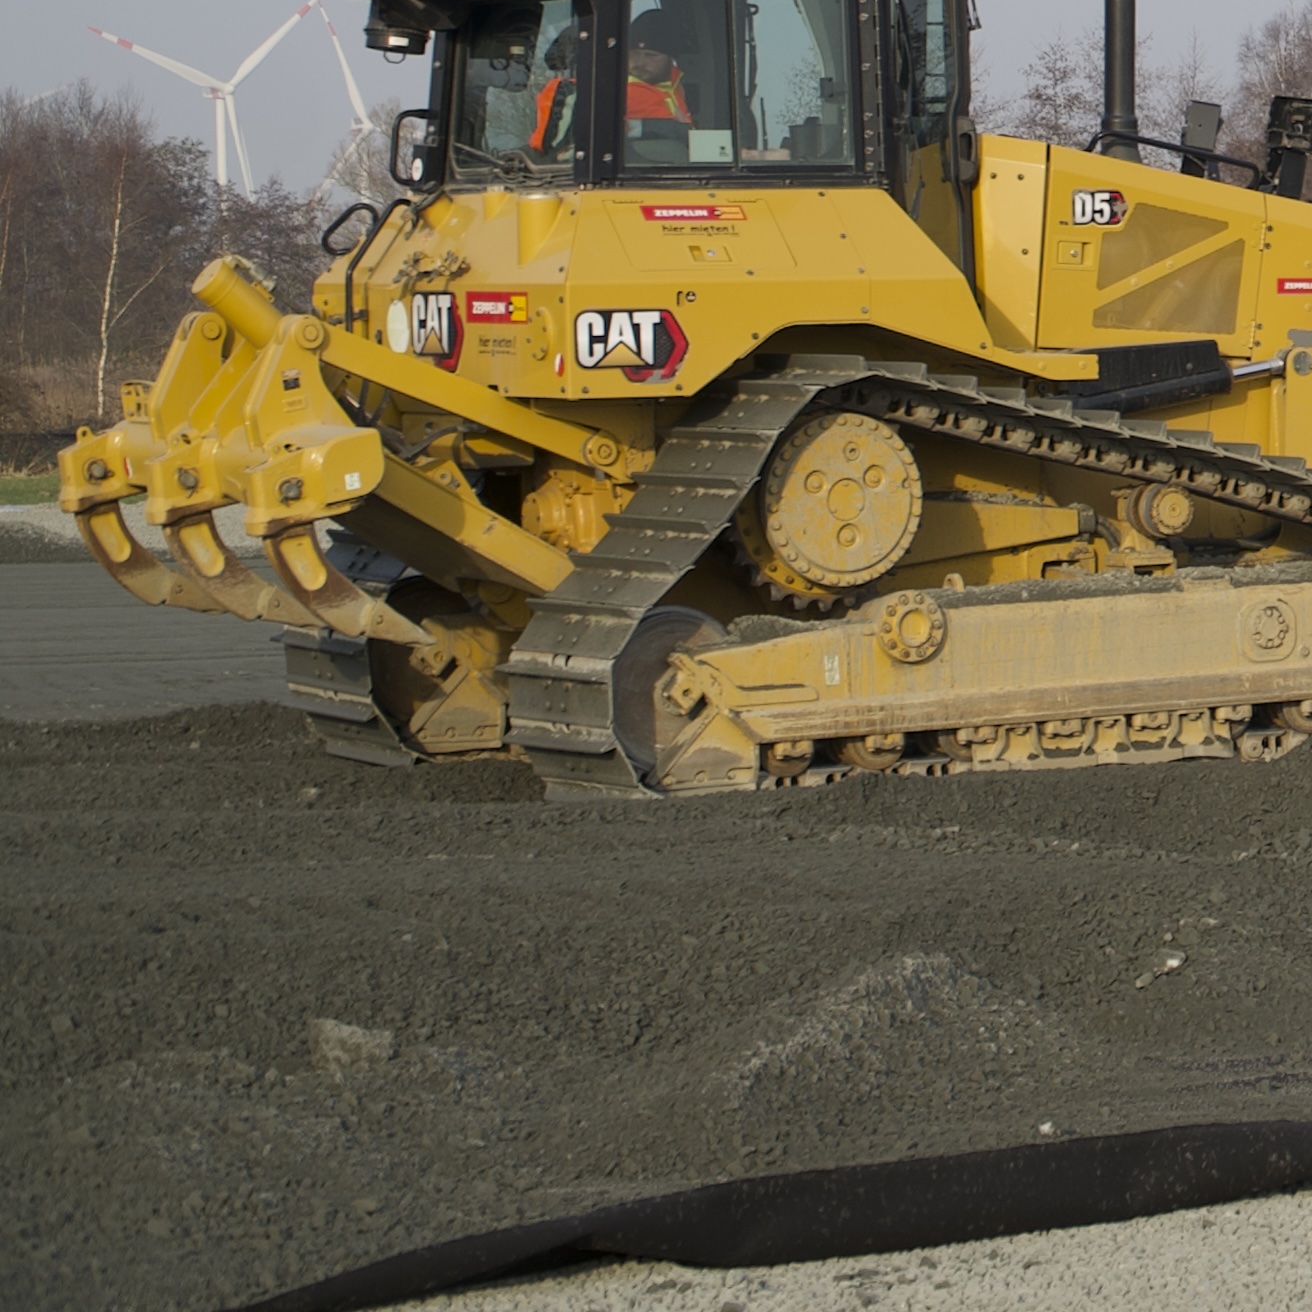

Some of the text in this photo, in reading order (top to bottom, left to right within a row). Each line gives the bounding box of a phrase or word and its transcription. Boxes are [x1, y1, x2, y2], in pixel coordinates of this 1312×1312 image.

[653, 209, 708, 217] ZEPPELIN
[1074, 192, 1111, 224] D5
[662, 225, 685, 233] hier
[472, 301, 506, 315] ZEPPELIN
[412, 294, 451, 354] CAT
[576, 311, 661, 368] CAT
